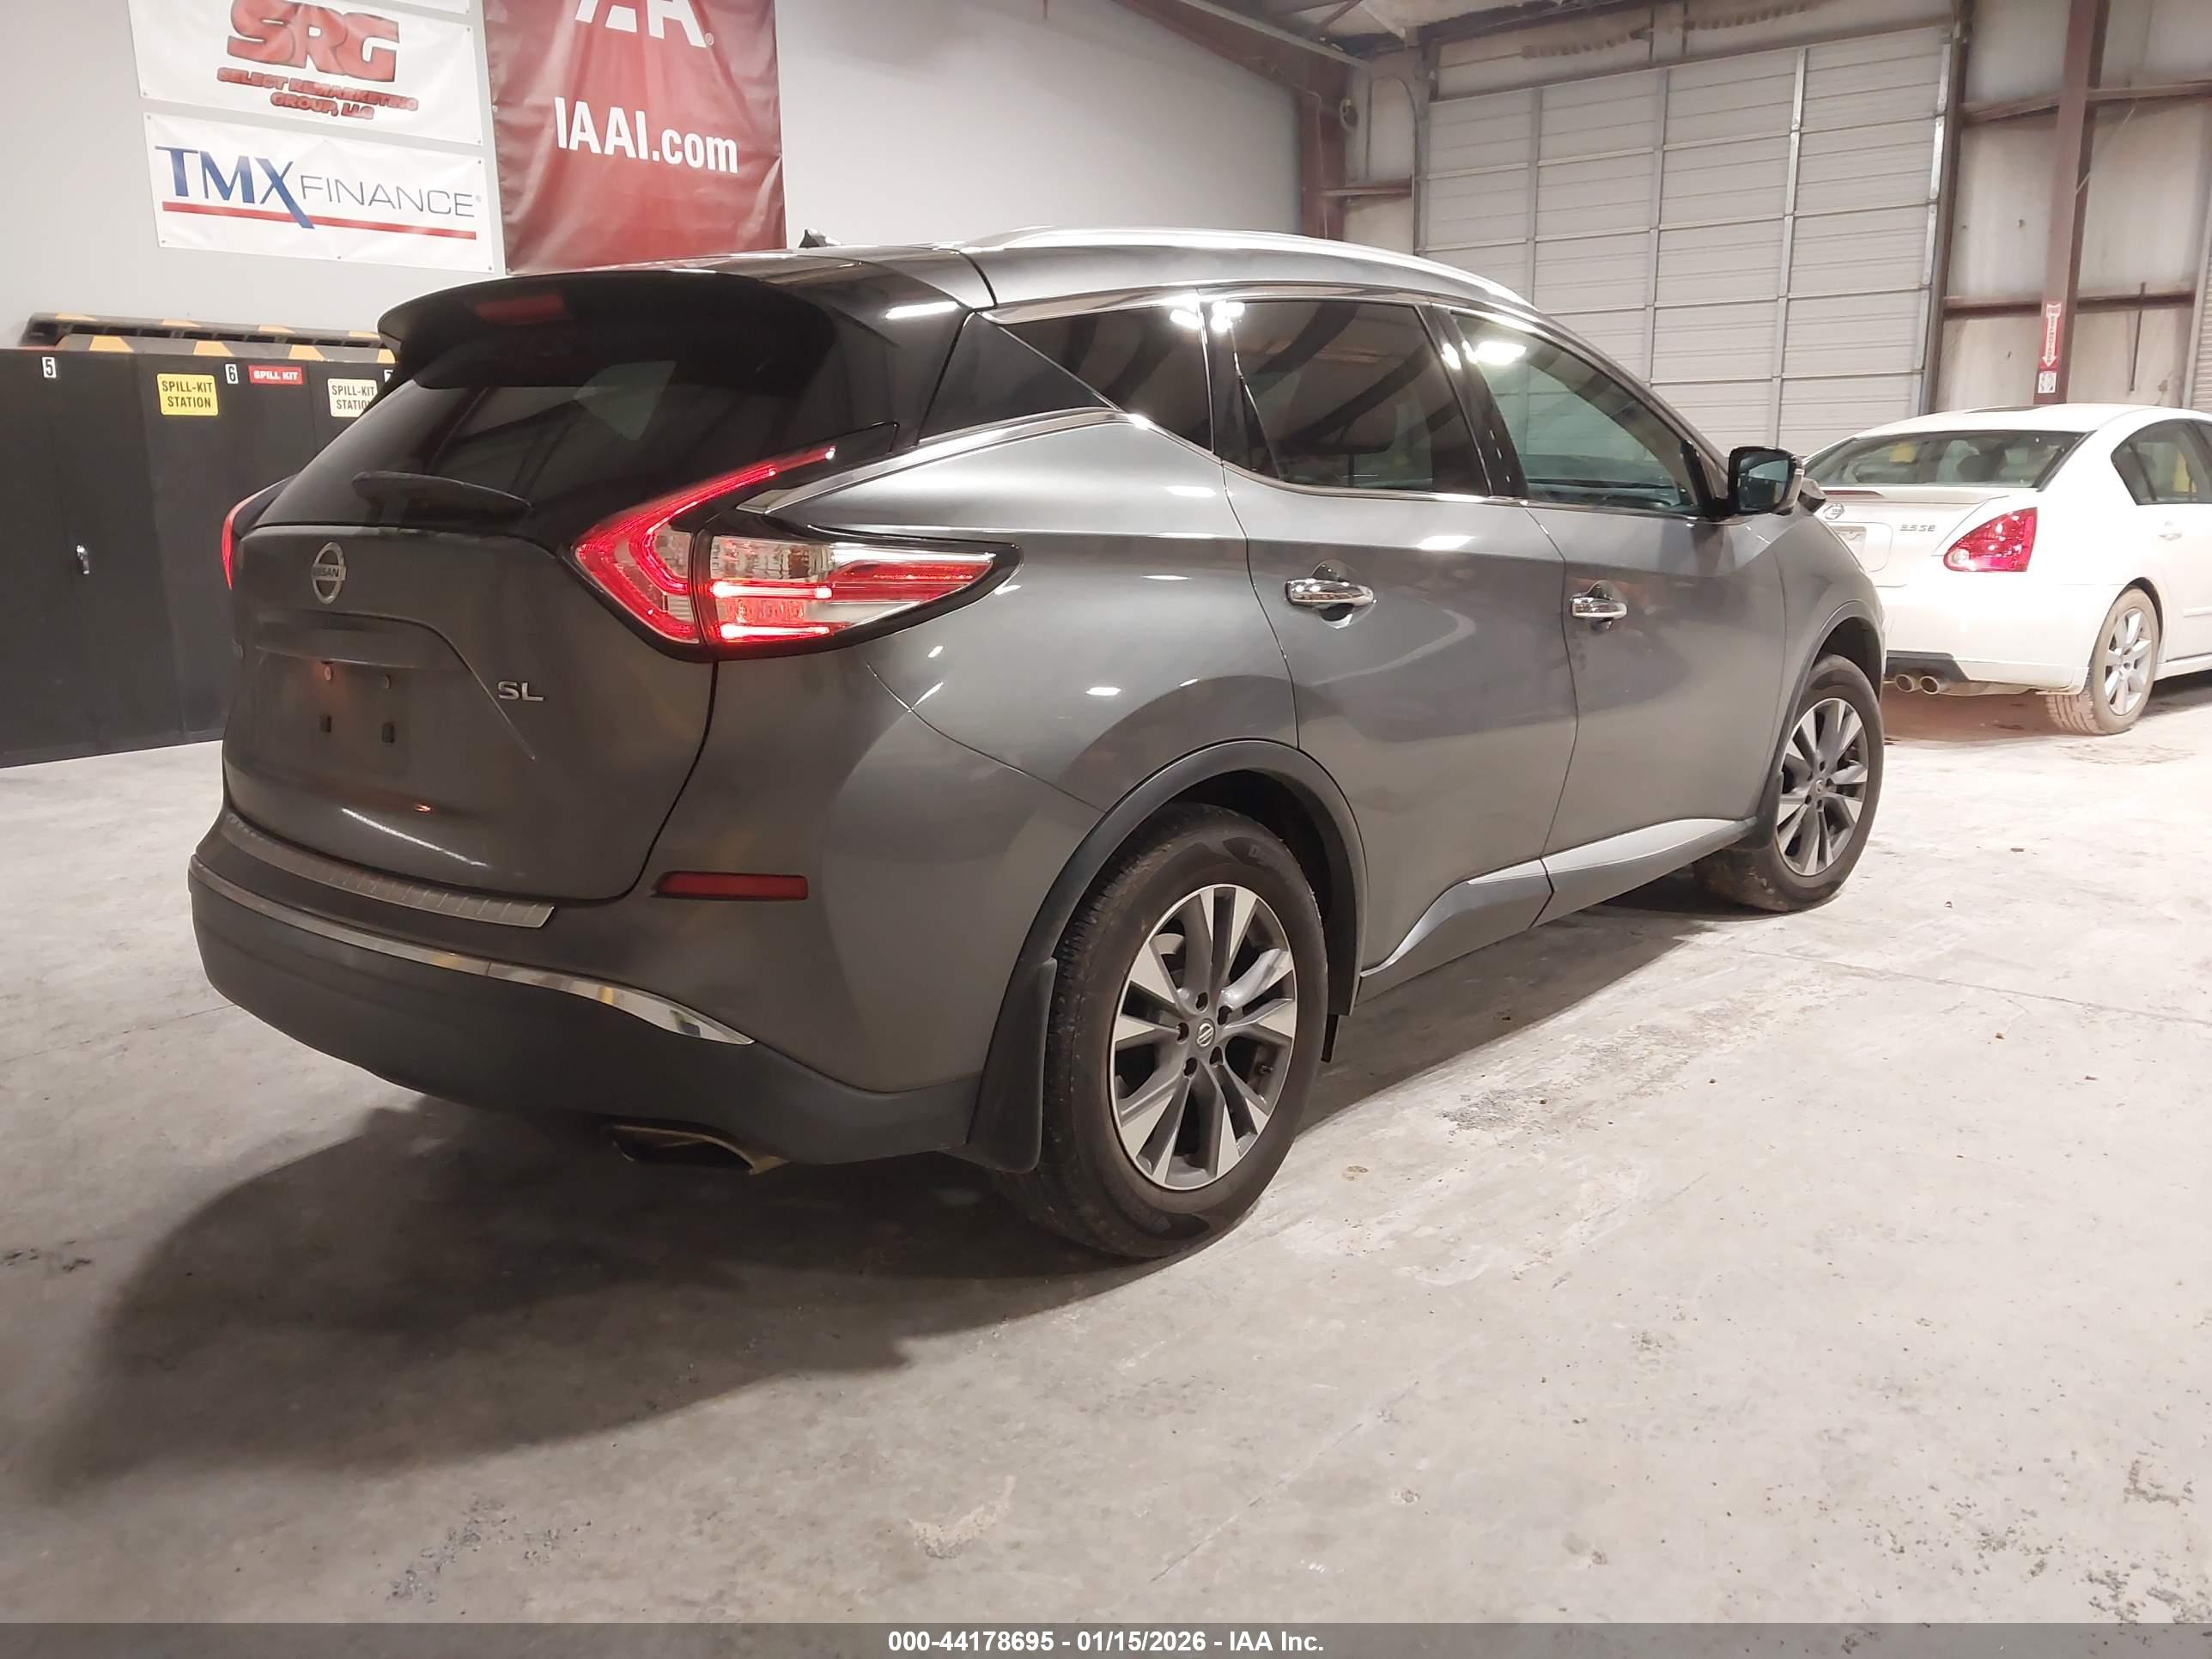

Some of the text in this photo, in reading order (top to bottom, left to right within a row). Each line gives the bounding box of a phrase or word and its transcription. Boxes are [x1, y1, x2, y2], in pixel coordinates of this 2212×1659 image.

[227, 0, 400, 82] SRG
[554, 96, 738, 174] IAAI.com
[155, 145, 477, 229] TMX FINANCE
[45, 359, 54, 377] 5
[228, 366, 237, 382] 6
[253, 370, 299, 381] SPILL KIT
[161, 380, 213, 393] SPILL-KIT
[331, 384, 375, 397] SPILL-KIT
[167, 396, 211, 408] STATION
[336, 398, 371, 410] STATIO
[497, 680, 544, 702] SL
